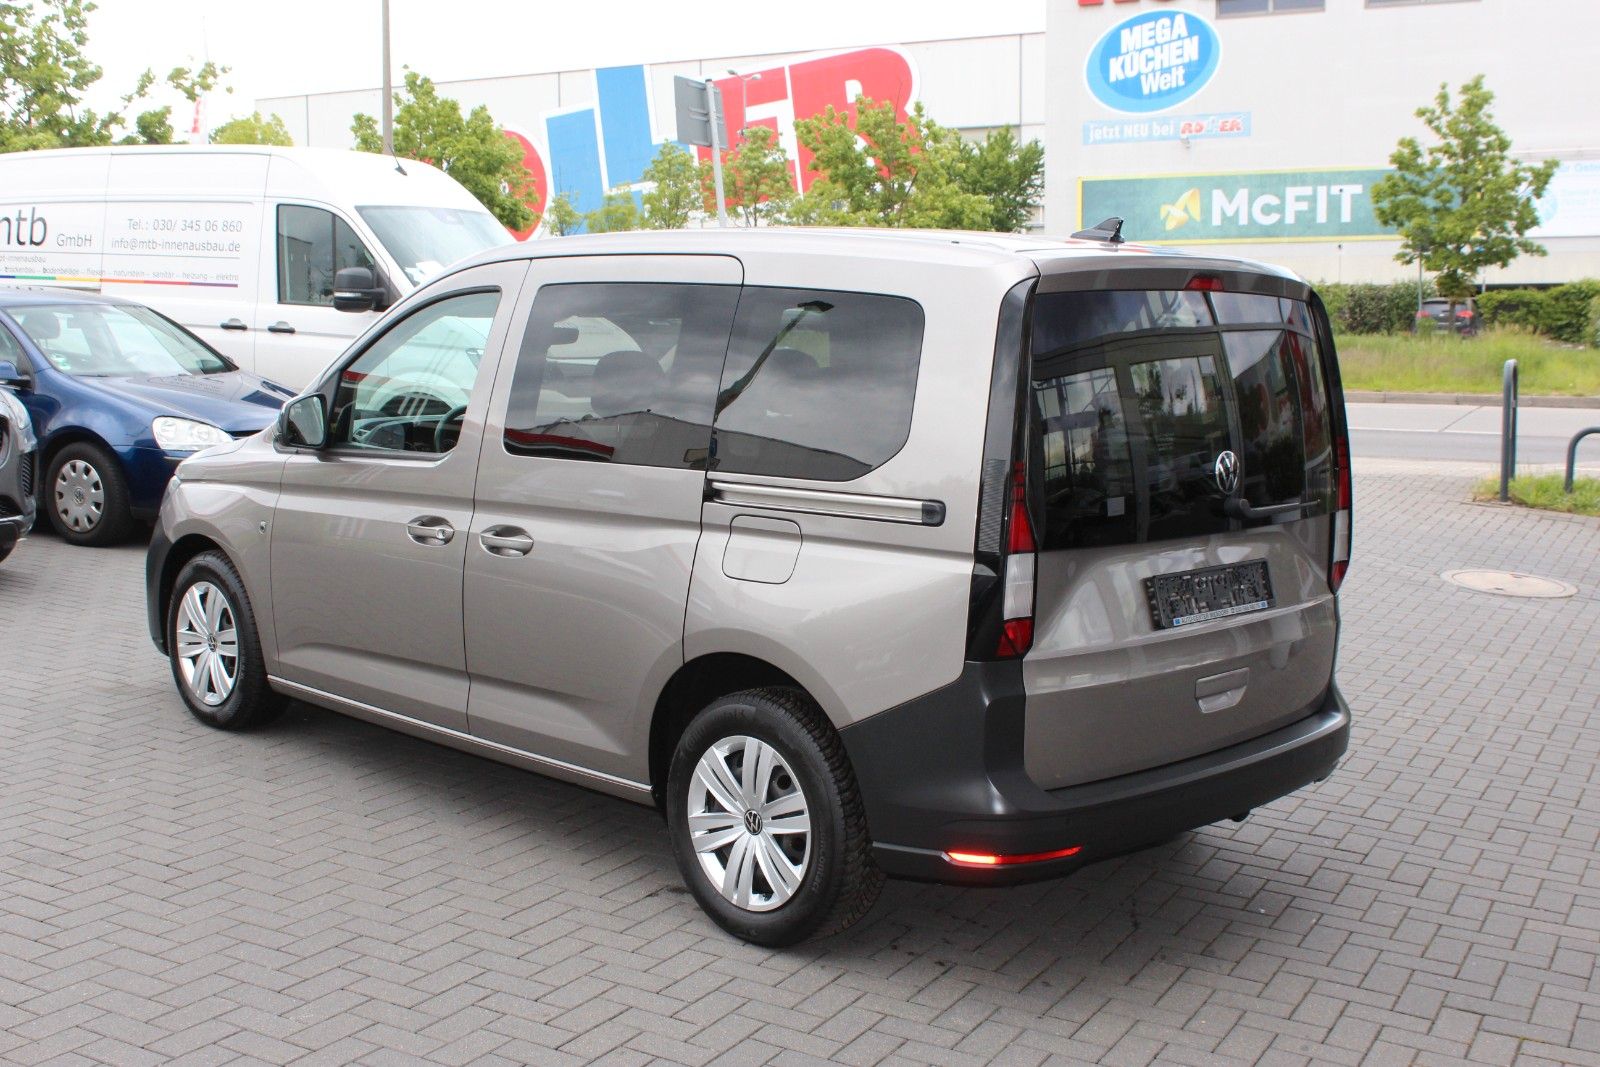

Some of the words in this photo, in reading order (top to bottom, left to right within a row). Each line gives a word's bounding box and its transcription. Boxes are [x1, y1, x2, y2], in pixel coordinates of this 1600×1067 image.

[1121, 13, 1188, 53] MEGA
[1140, 65, 1186, 96] Welt
[1089, 123, 1121, 142] jetzt
[1124, 122, 1149, 138] NEU
[1152, 121, 1174, 136] bei
[1211, 184, 1363, 227] McFIT
[153, 219, 176, 232] 030/
[181, 219, 201, 232] 345
[205, 219, 218, 232] 06
[222, 220, 243, 233] 860
[56, 233, 92, 248] GmbH
[111, 238, 241, 253] info@mtb-innenausbau.de
